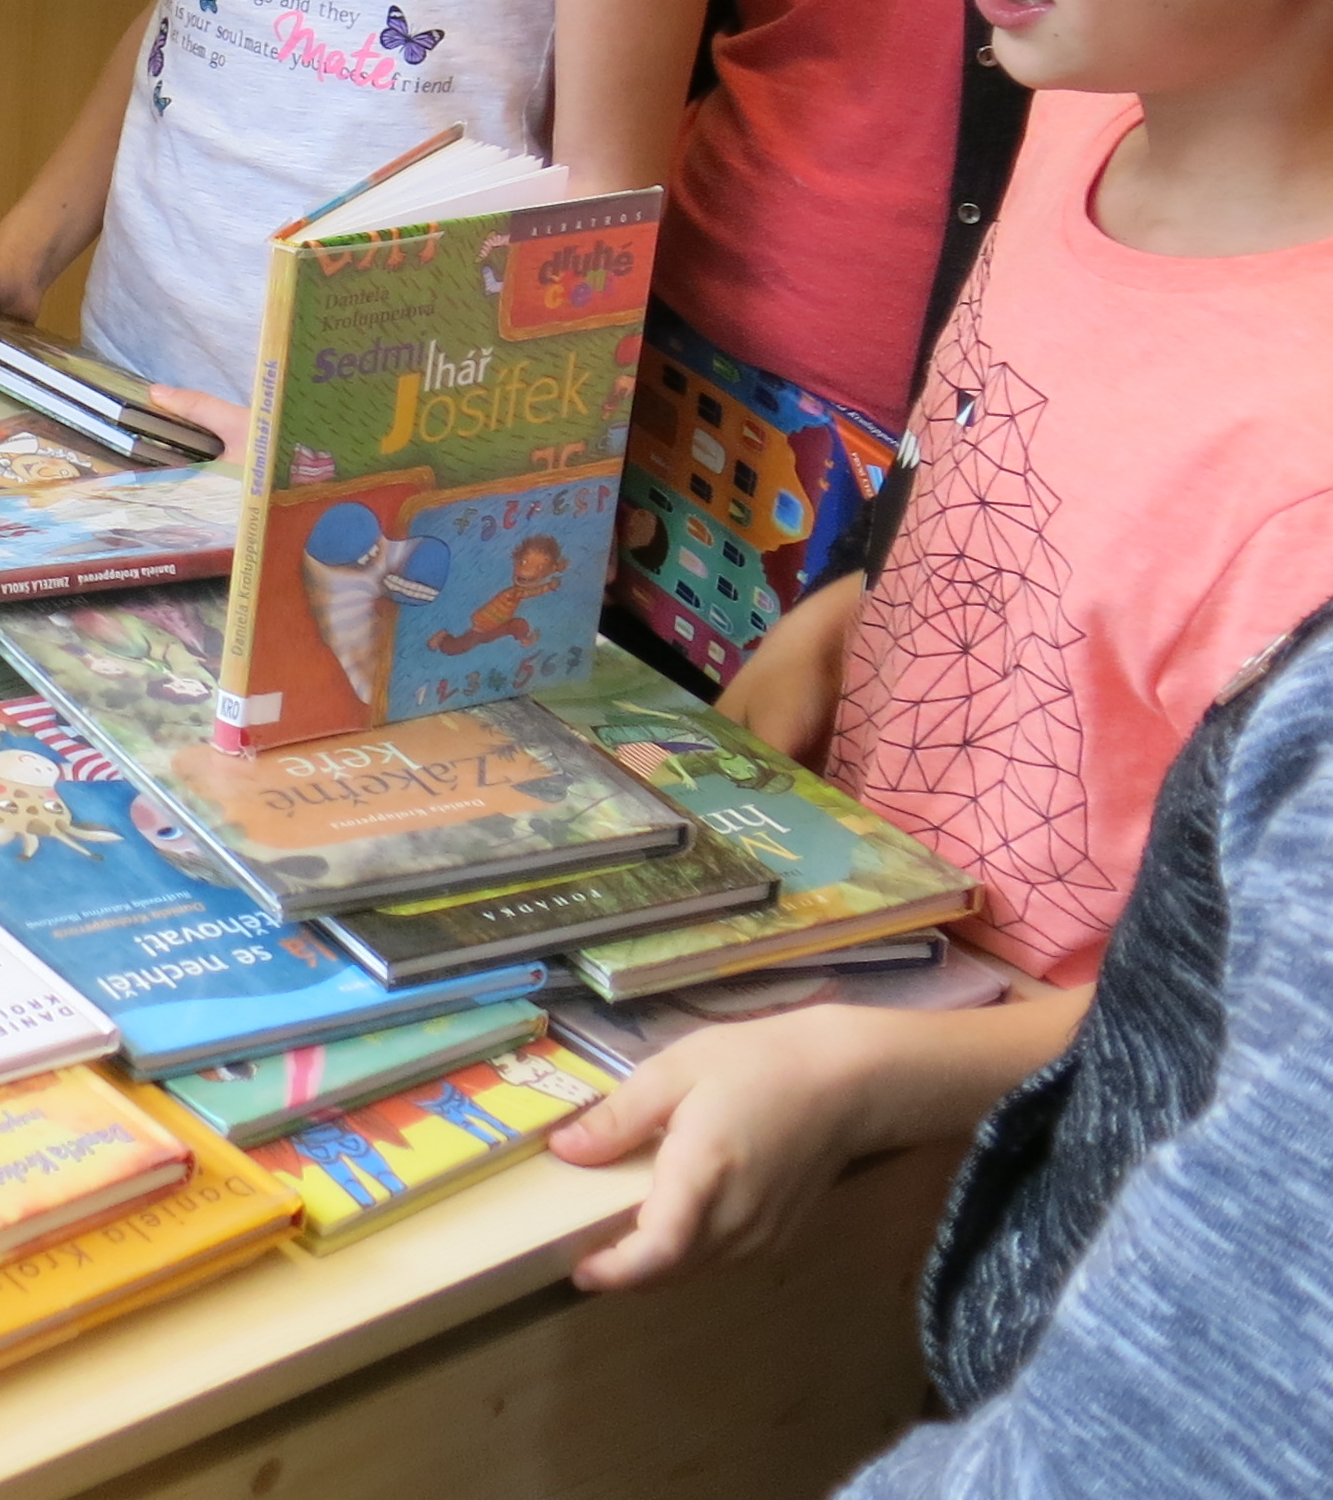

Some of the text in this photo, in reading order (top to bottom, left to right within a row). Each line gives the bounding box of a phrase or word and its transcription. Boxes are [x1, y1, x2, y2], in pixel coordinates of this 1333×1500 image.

[184, 11, 211, 31] your
[319, 1, 360, 29] they
[210, 51, 226, 69] go
[532, 211, 643, 237] ALBATROS
[324, 288, 390, 311] Daniela
[260, 359, 278, 412] Josífek
[381, 352, 591, 454] Josífek
[0, 580, 30, 596] ŠKOLA
[233, 506, 261, 656] Daniela Krolupperová
[220, 700, 241, 720] KRO
[279, 738, 422, 784] keře
[258, 753, 511, 818] Zákeřné
[479, 885, 603, 923] POHÁDKA
[134, 908, 281, 957] těhovat!
[231, 944, 274, 969] se
[95, 953, 230, 1001] nechtěl
